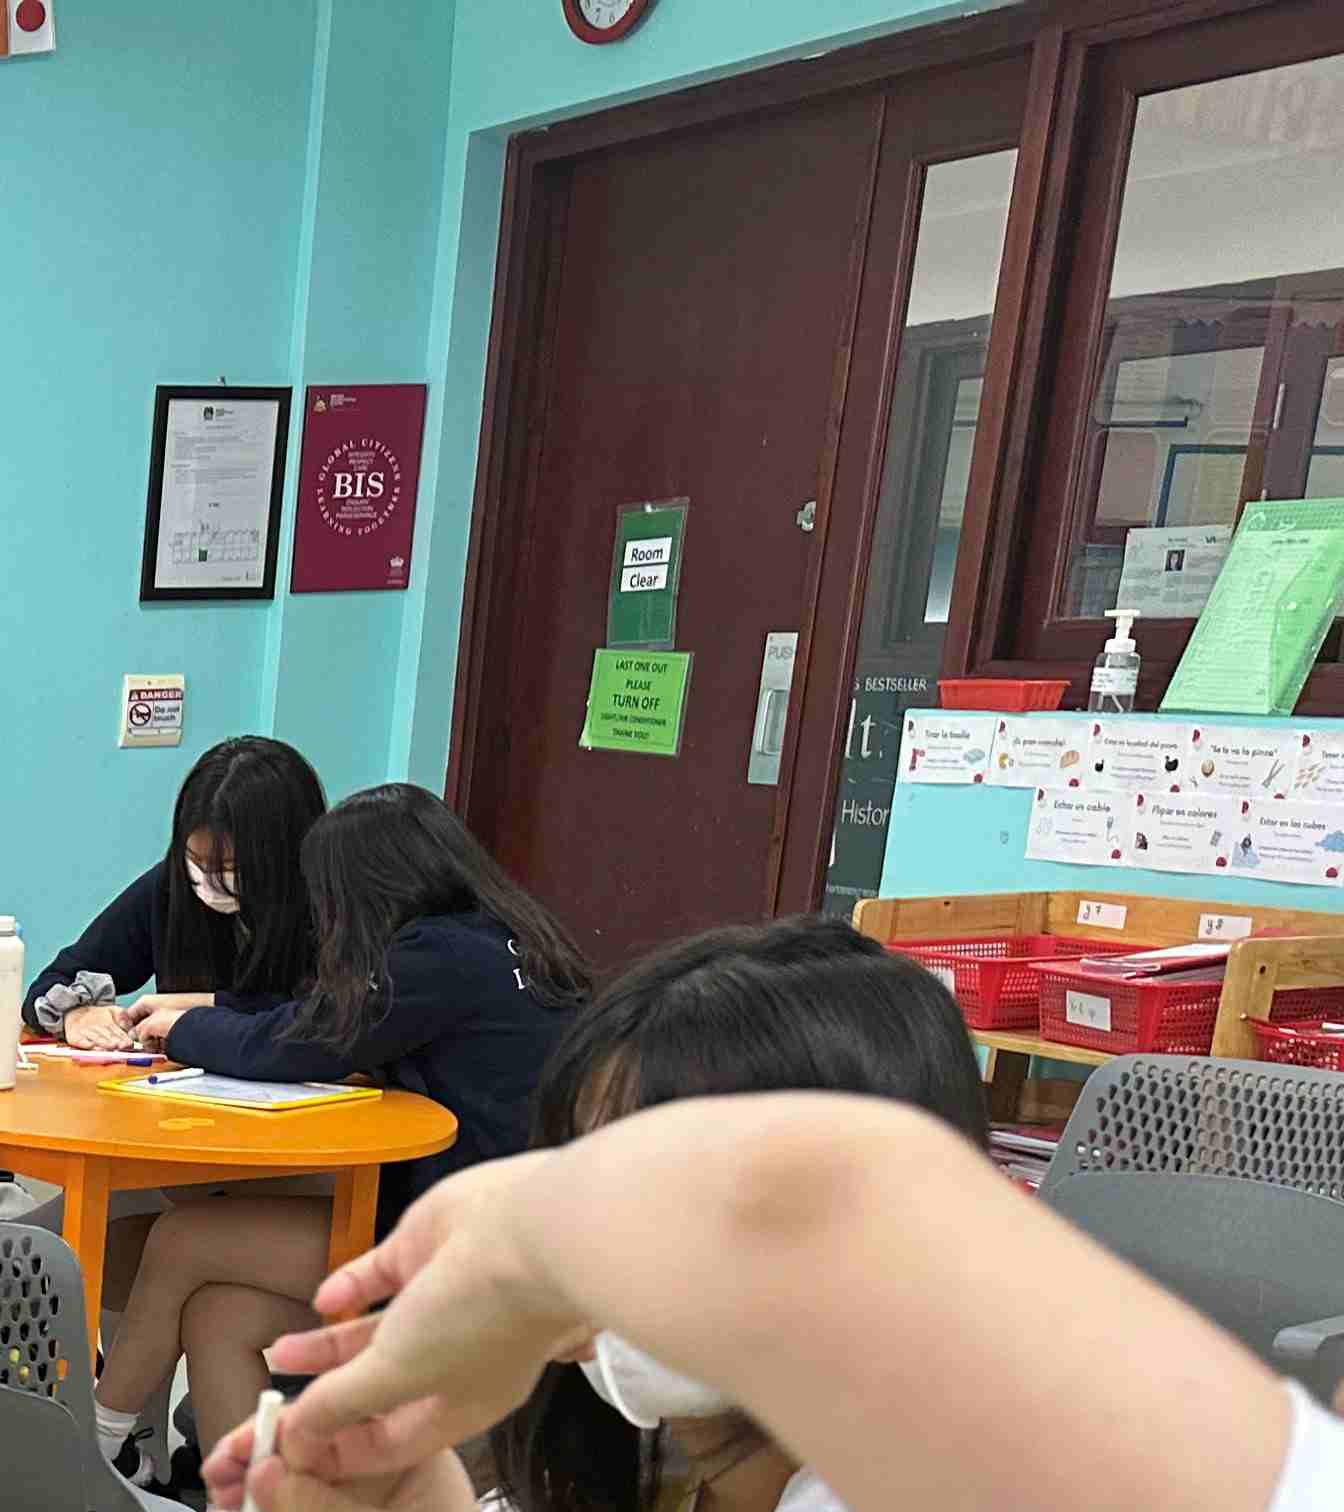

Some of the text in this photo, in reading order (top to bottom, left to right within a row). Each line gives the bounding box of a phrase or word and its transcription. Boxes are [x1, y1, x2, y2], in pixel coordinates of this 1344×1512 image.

[333, 472, 385, 499] BIS
[630, 546, 663, 562] Room
[629, 572, 659, 589] Clear
[615, 659, 668, 674] LAST ONE OUT
[625, 679, 652, 691] PLEASE
[865, 678, 928, 692] BESTSELLER
[140, 690, 181, 699] DANGER
[612, 694, 660, 712] TURN OFF
